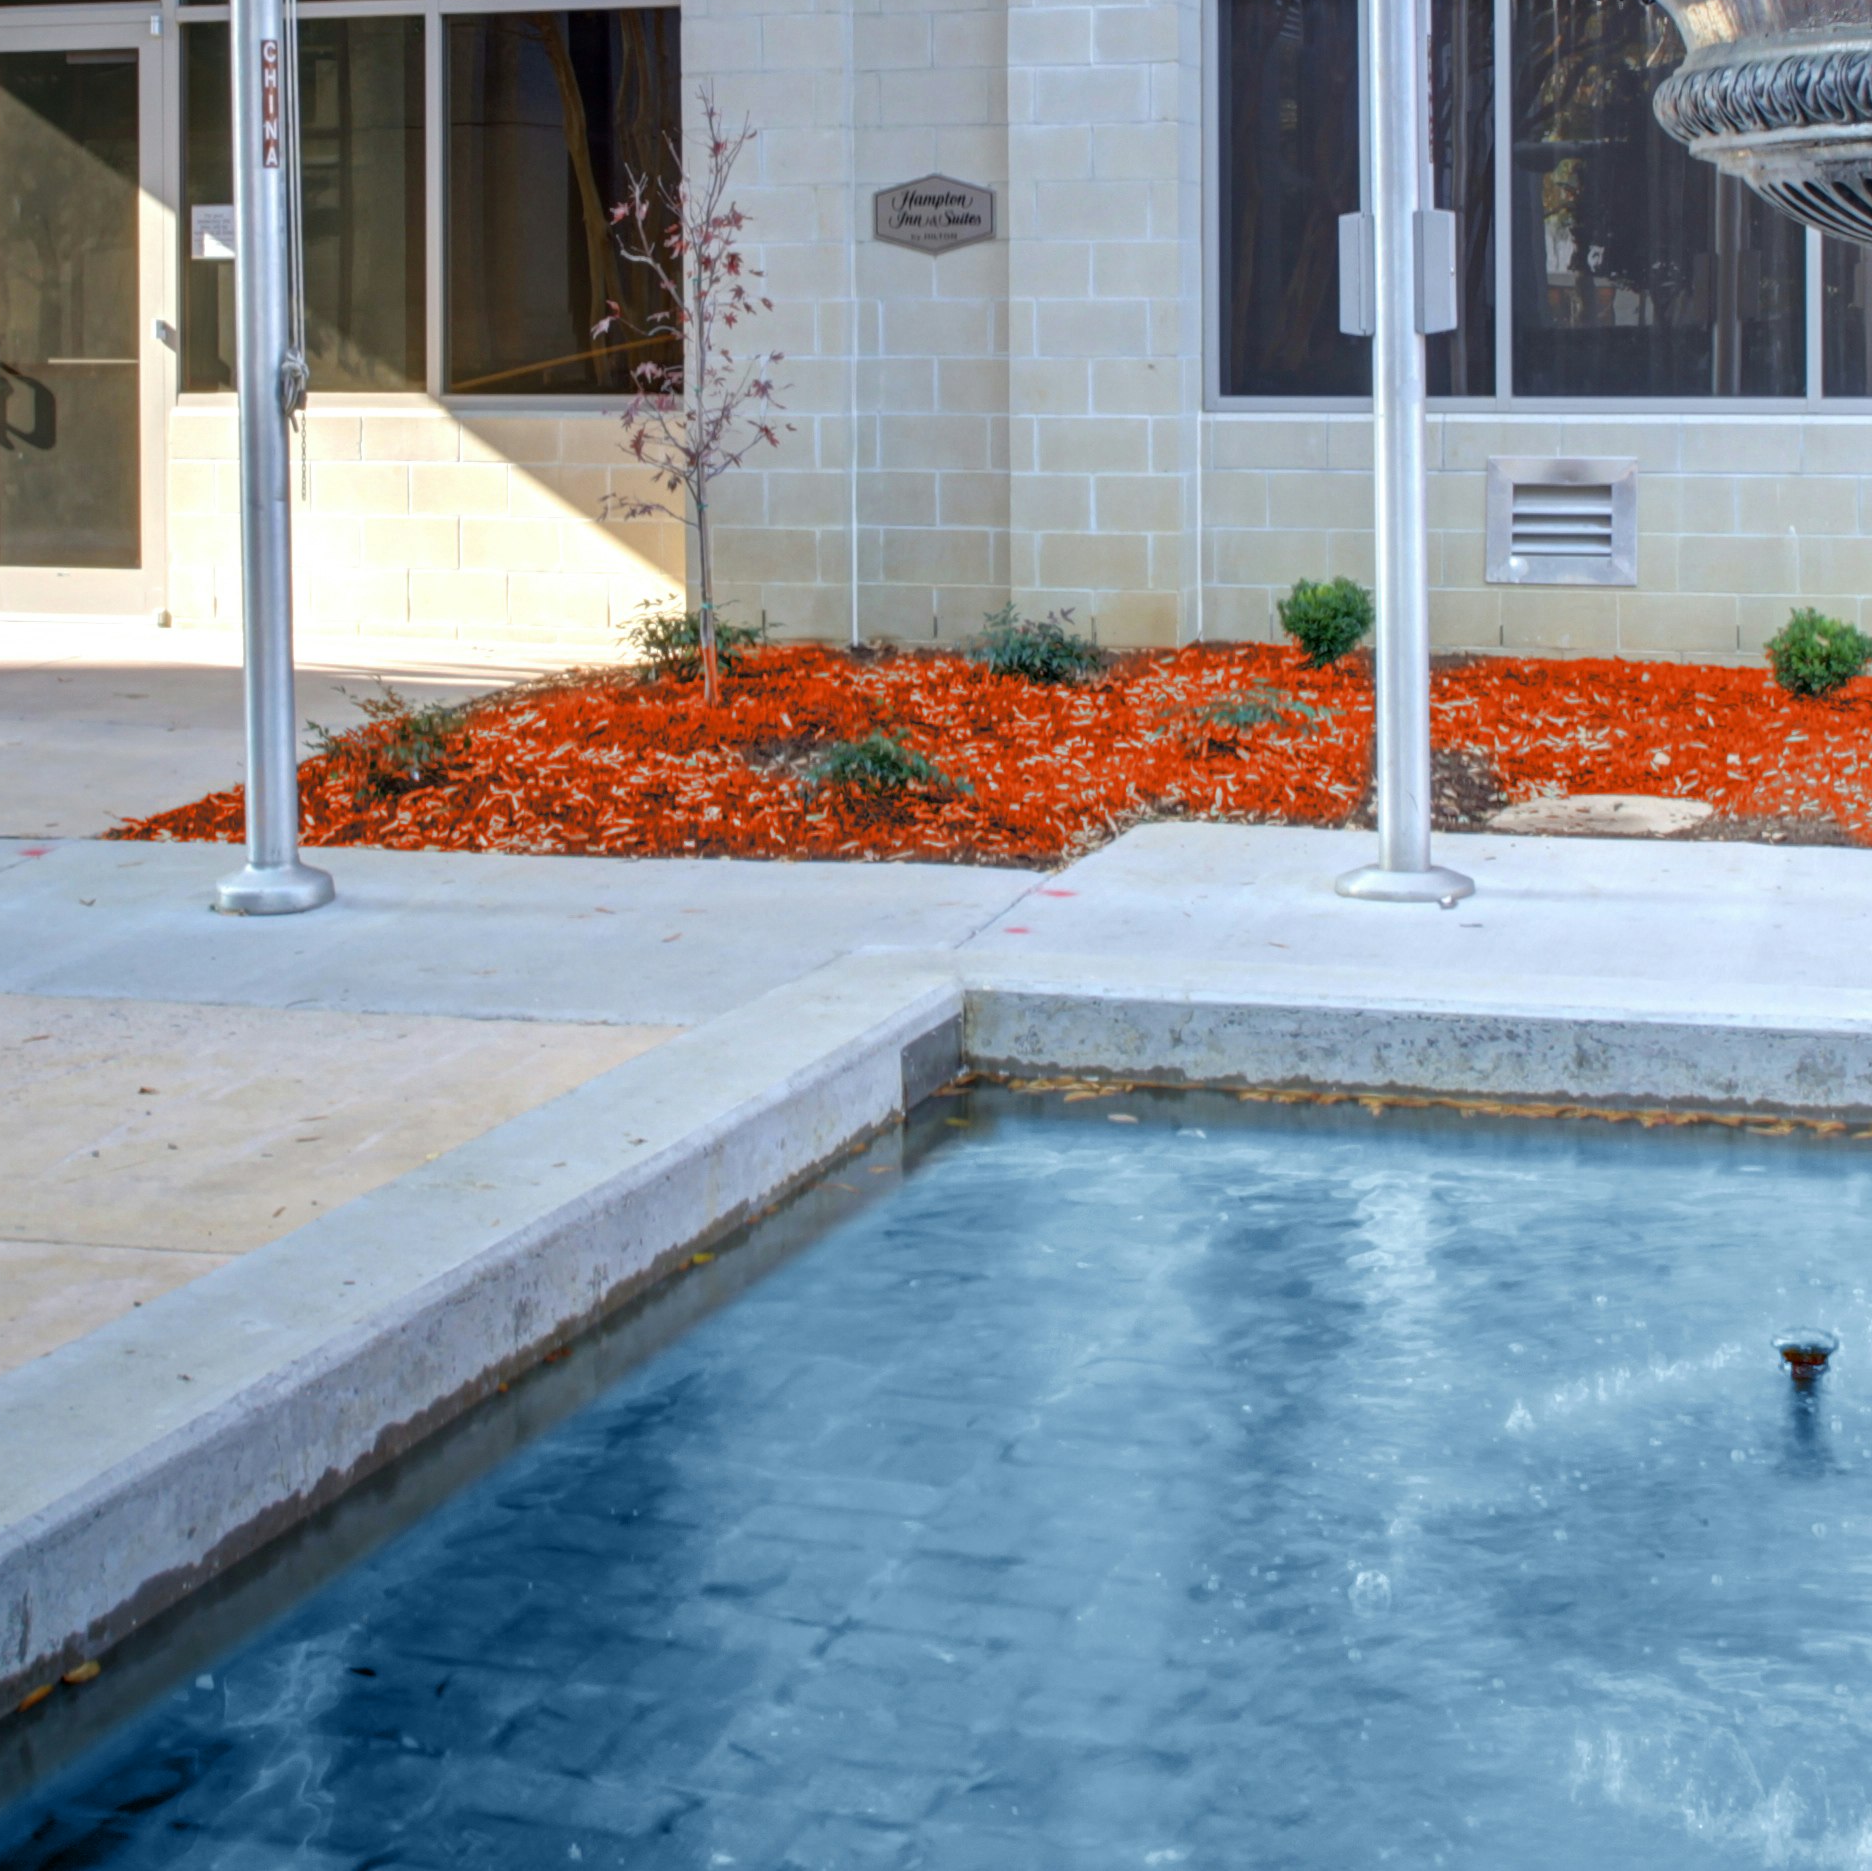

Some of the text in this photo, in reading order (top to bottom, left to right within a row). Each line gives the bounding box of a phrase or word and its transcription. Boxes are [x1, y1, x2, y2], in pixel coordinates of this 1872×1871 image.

[263, 40, 278, 166] CHINA
[891, 189, 974, 212] Hampton
[888, 210, 929, 230] Inn
[939, 210, 982, 229] Suites
